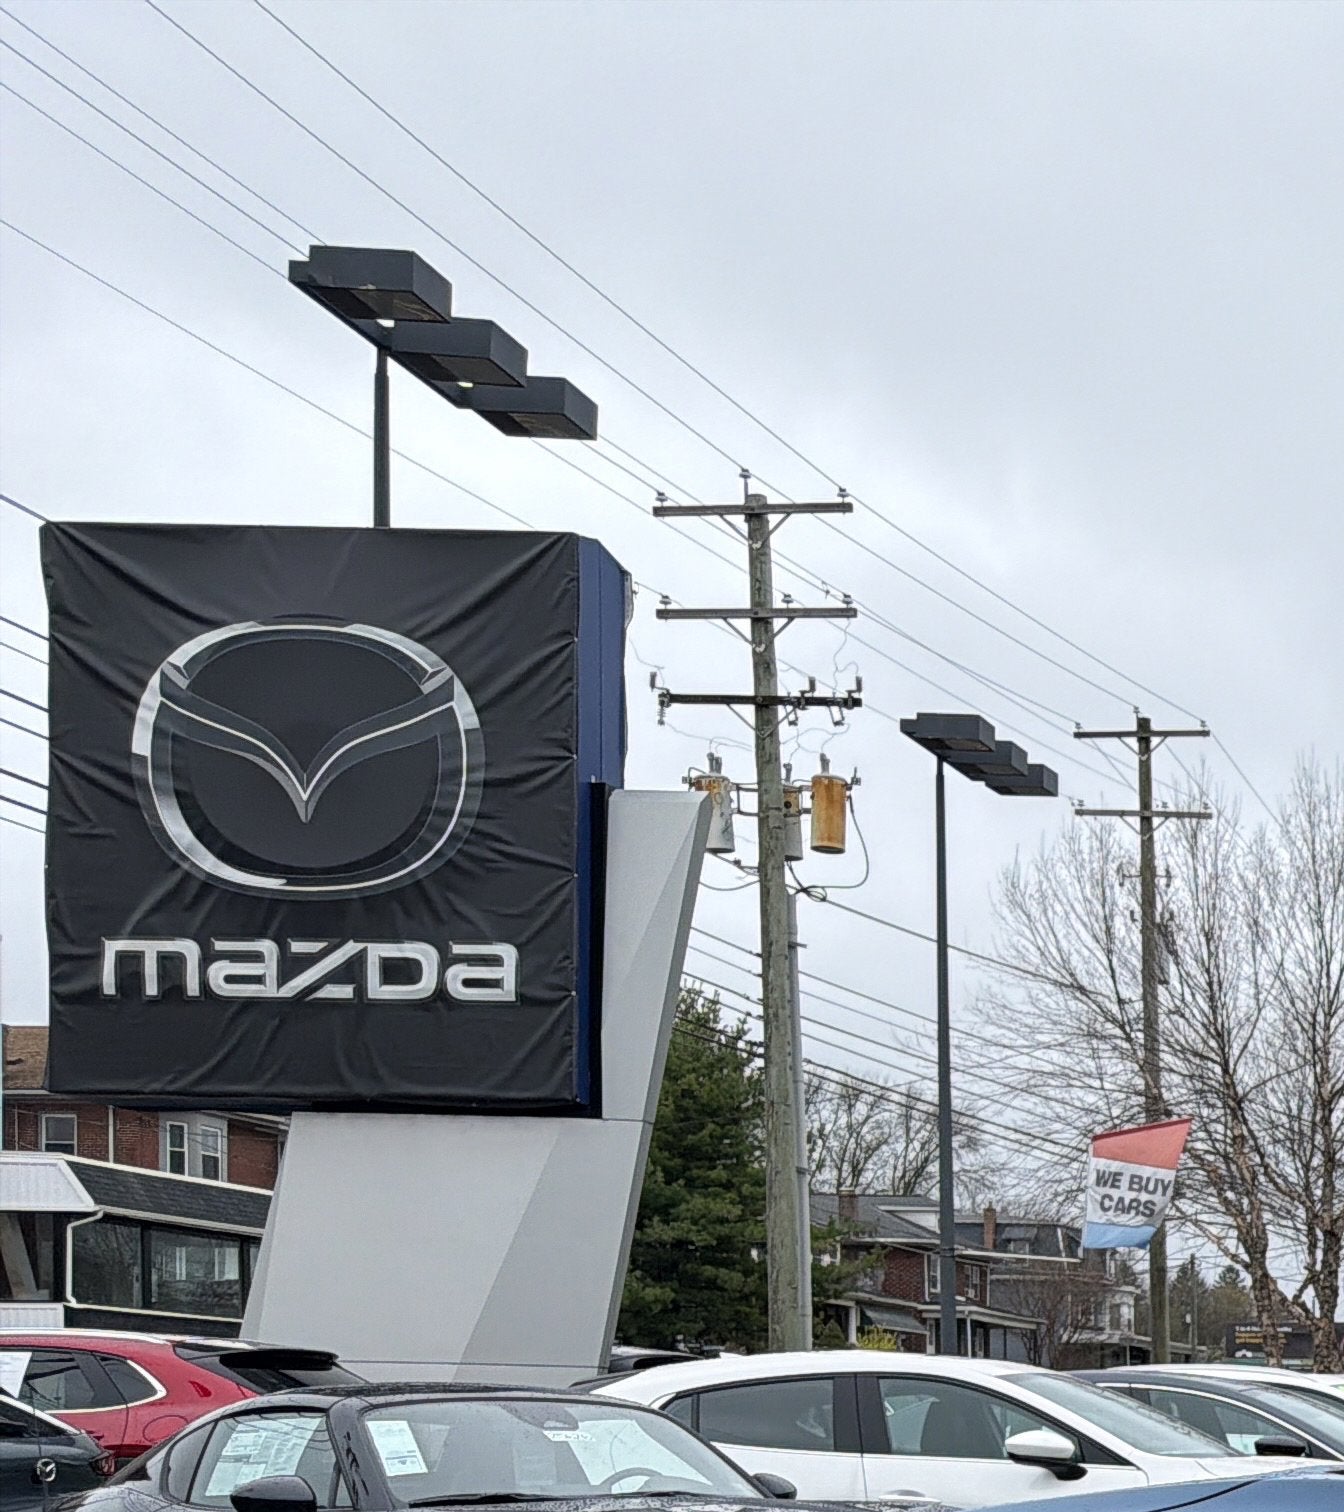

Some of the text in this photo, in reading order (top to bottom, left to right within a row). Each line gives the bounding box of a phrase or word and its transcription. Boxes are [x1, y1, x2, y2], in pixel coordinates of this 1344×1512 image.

[101, 935, 520, 1003] mazda
[1095, 1168, 1172, 1197] WE BUY
[1099, 1193, 1157, 1218] CARS
